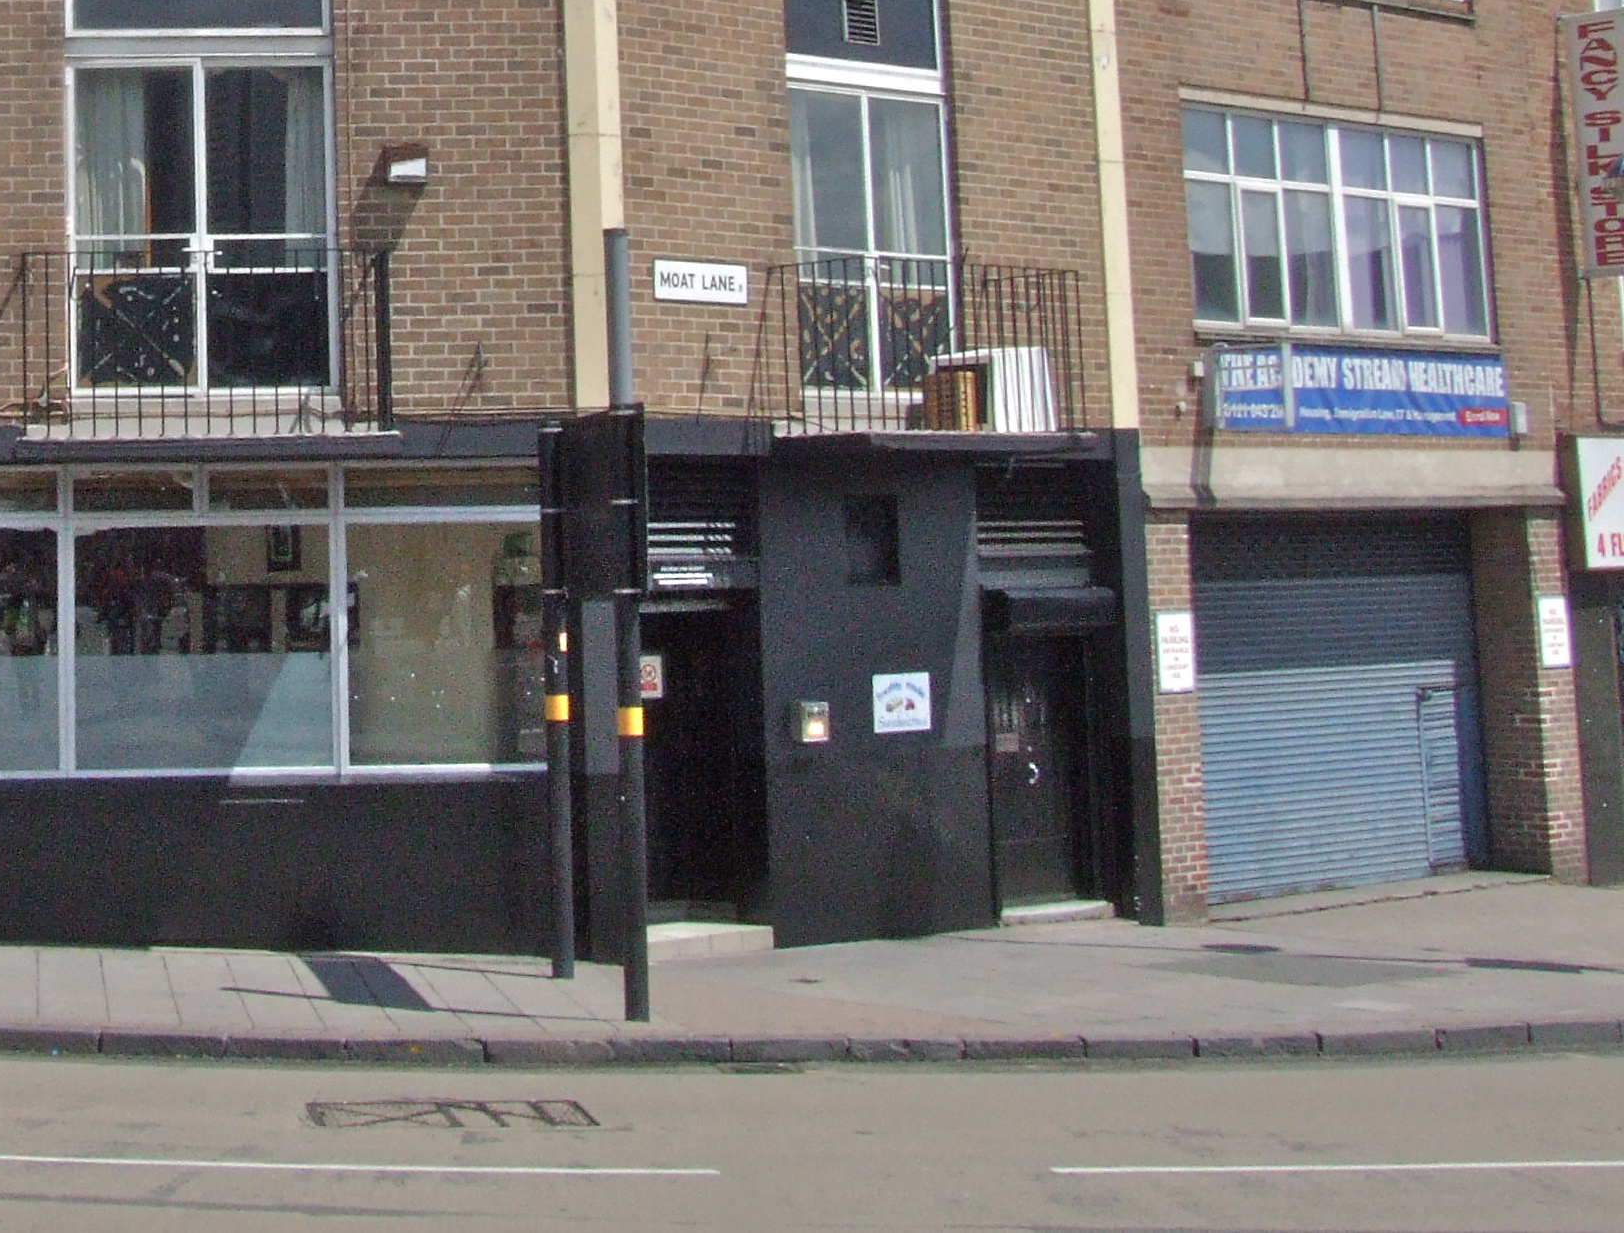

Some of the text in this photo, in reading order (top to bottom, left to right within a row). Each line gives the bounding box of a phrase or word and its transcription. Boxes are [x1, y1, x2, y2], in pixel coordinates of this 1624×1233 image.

[1577, 20, 1618, 101] FANCY
[660, 271, 695, 288] MOAT
[702, 274, 735, 291] LANE
[1220, 354, 1254, 386] THE
[1256, 354, 1337, 388] ACDEMY
[1408, 361, 1505, 397] HEALTHCARE
[1597, 533, 1605, 557] 4
